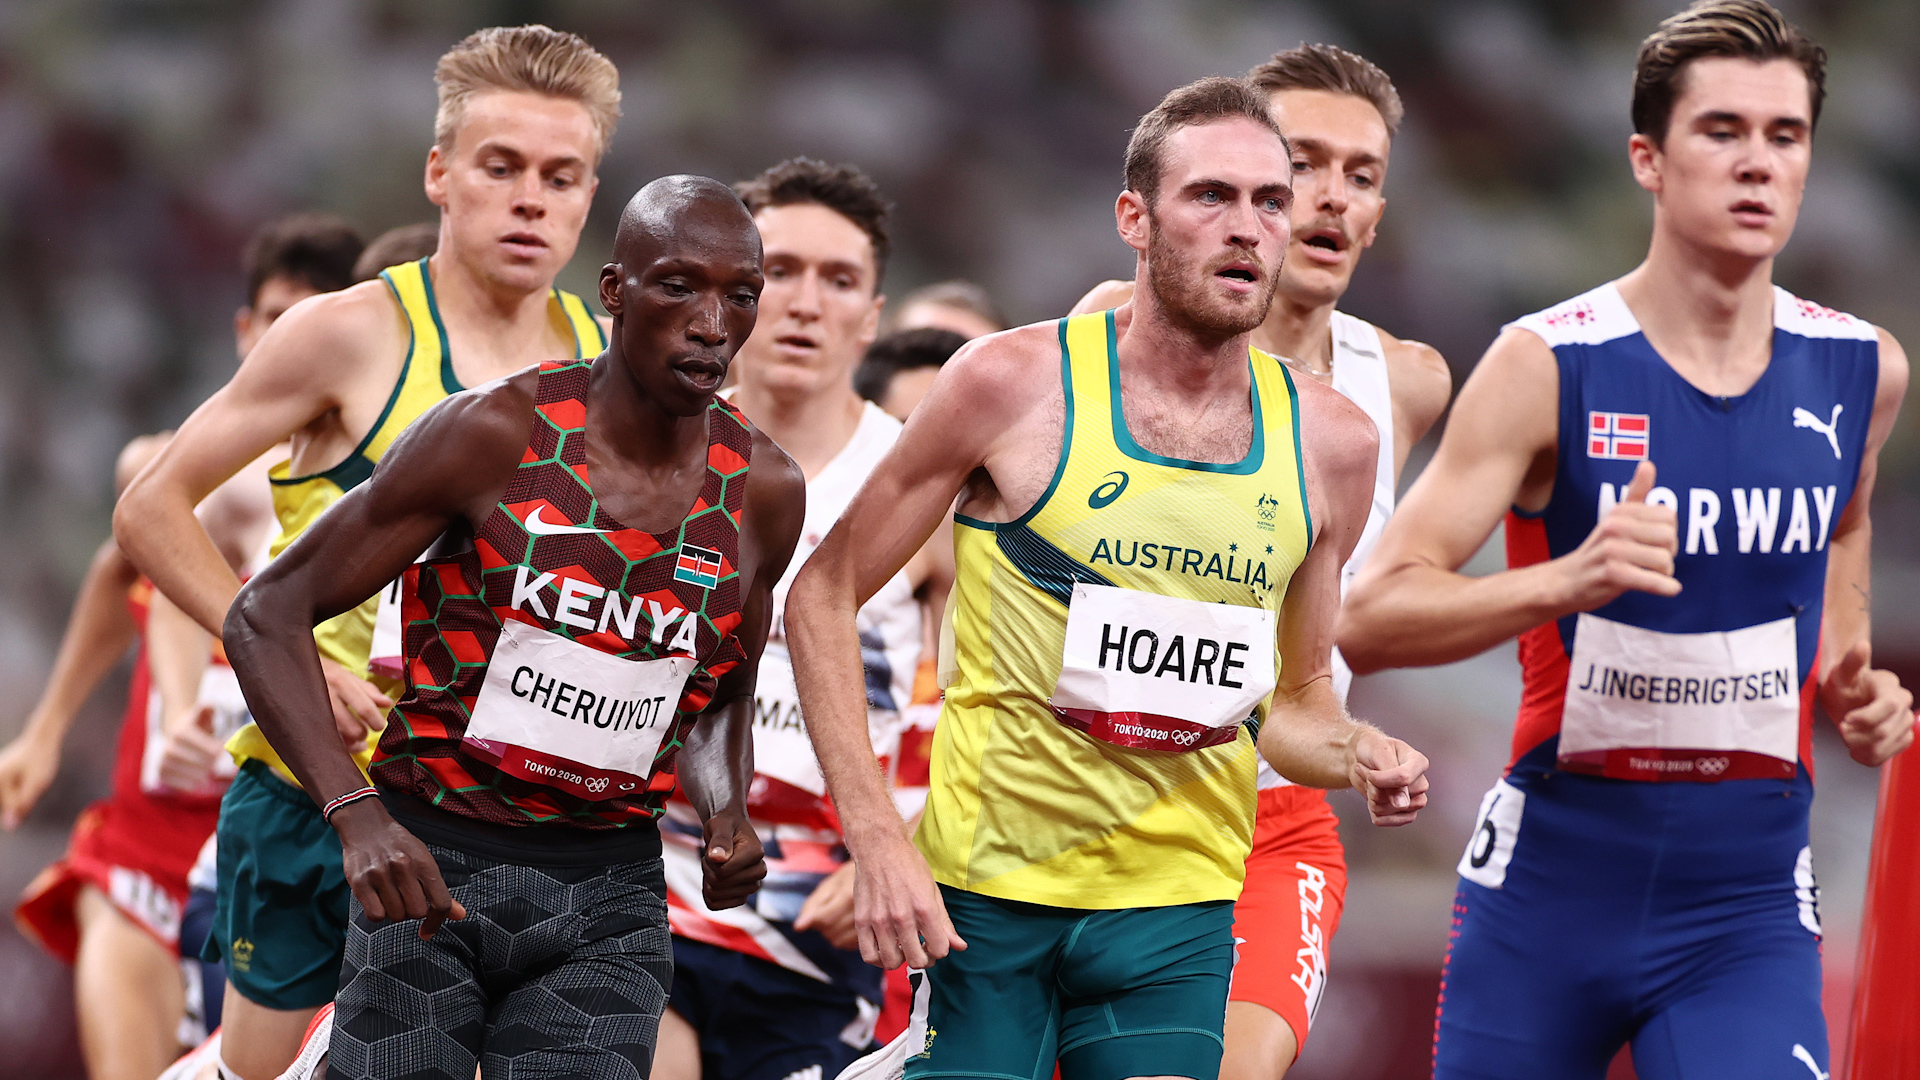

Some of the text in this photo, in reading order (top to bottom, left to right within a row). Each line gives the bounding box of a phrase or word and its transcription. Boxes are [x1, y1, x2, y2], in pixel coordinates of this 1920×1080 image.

[1089, 538, 1268, 590] AUSTRALIA
[511, 565, 698, 659] KENYA
[1098, 623, 1249, 690] HOARE
[1579, 663, 1788, 705] J.INGEBRIGTSEN
[511, 666, 666, 732] CHERUIYOT
[1114, 723, 1169, 741] TOKYO 2020
[524, 759, 583, 785] TOKYO 2020
[1291, 861, 1327, 998] POLSKA
